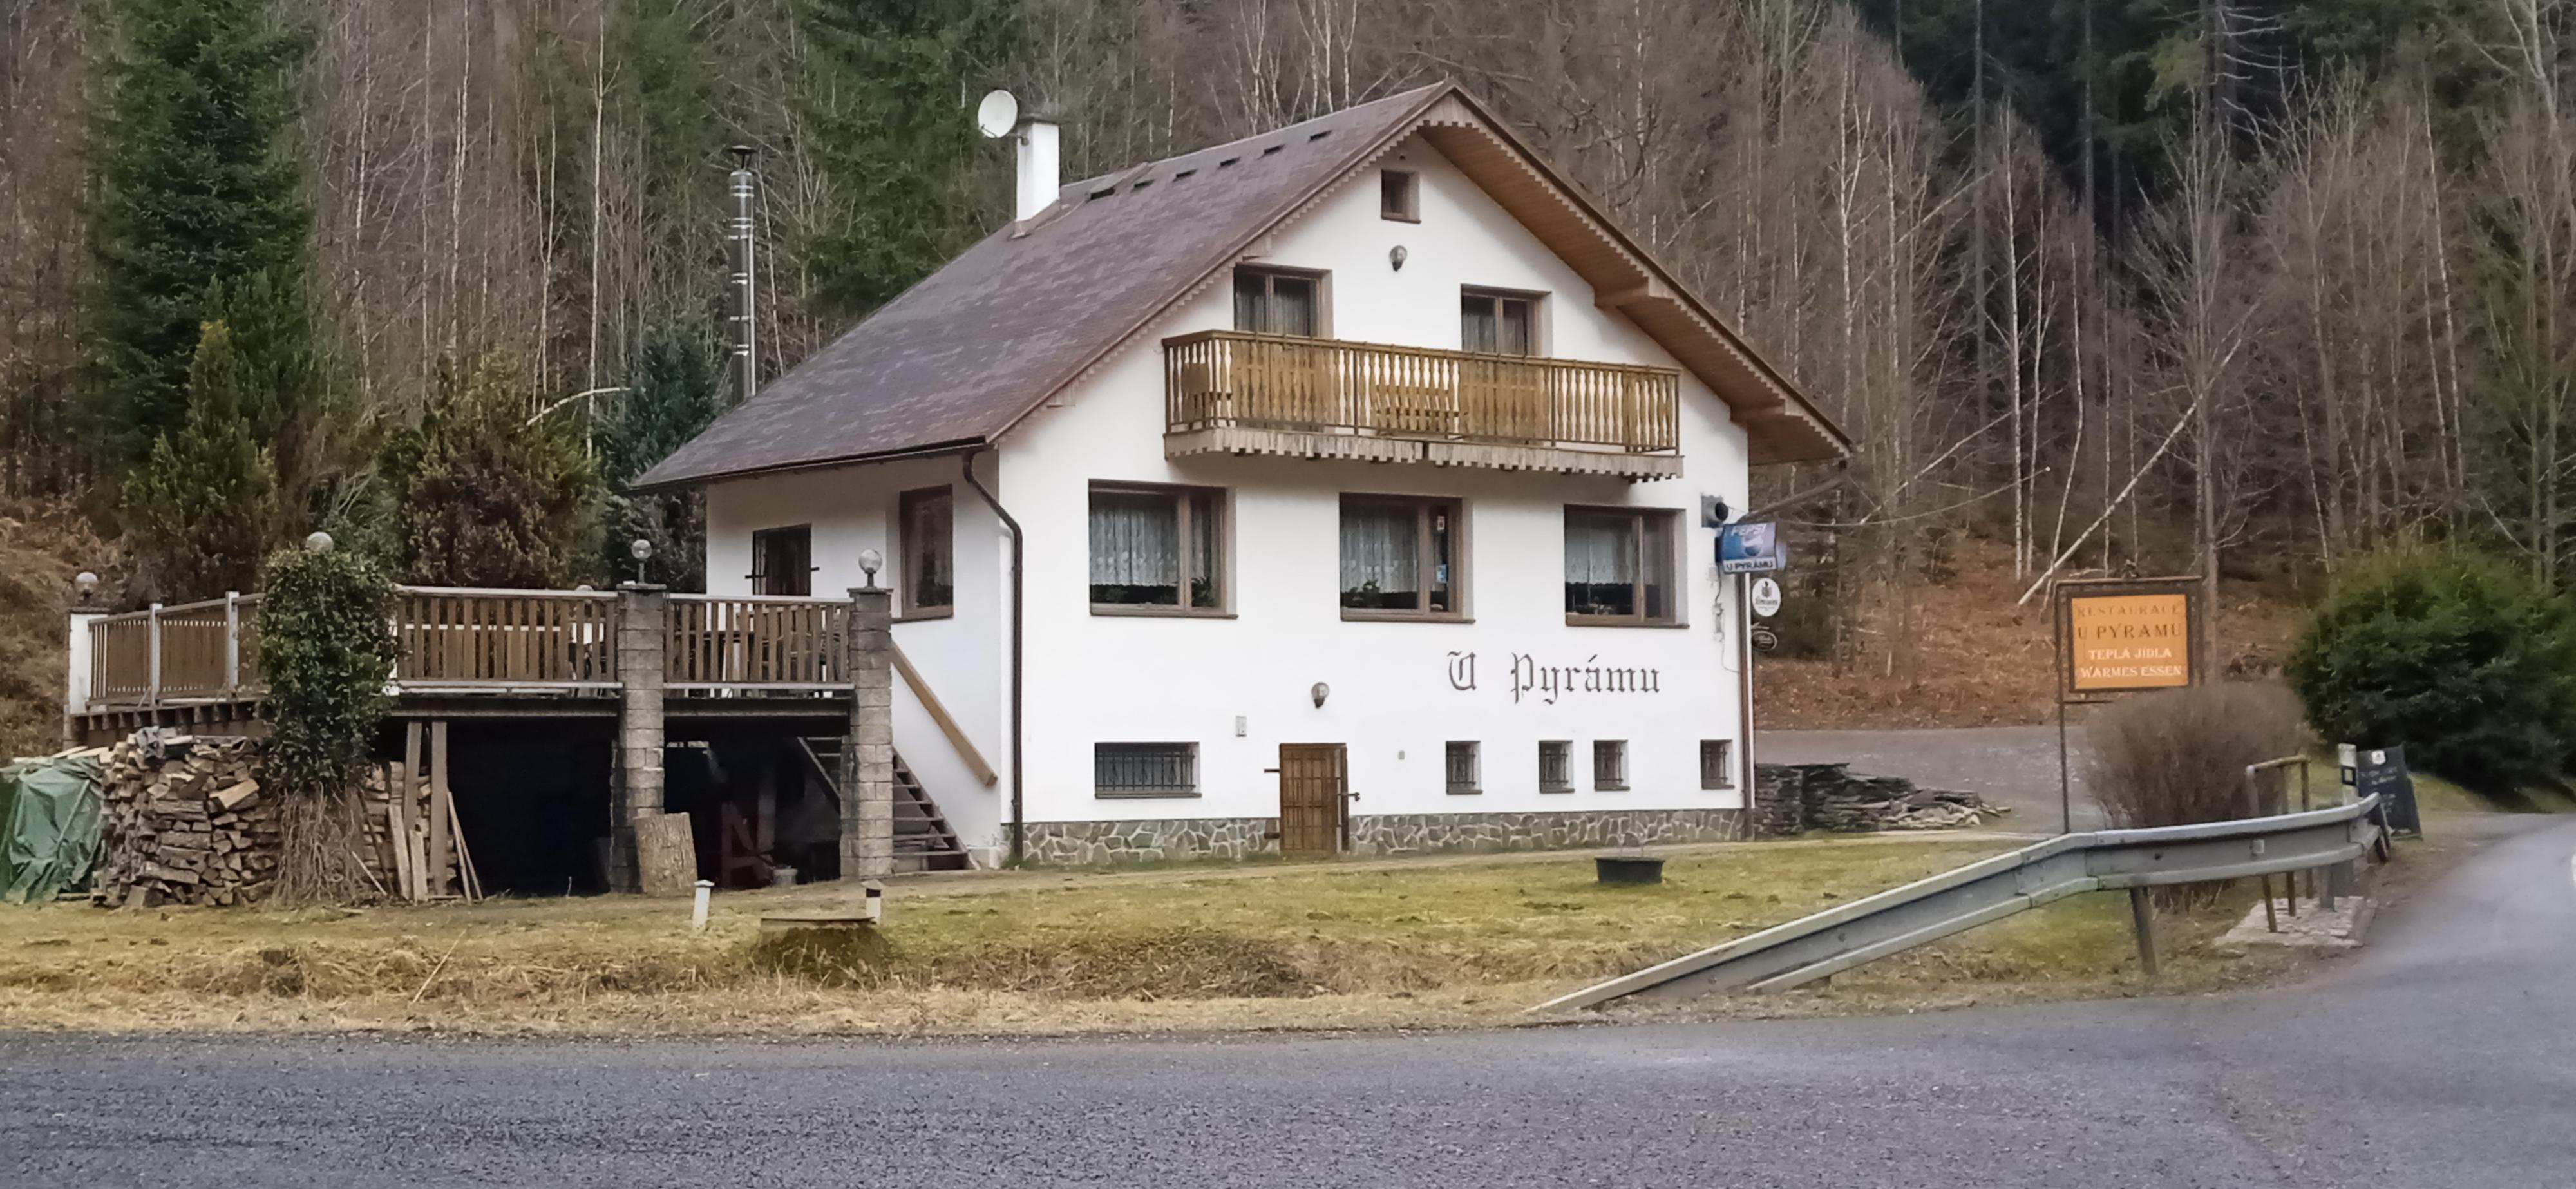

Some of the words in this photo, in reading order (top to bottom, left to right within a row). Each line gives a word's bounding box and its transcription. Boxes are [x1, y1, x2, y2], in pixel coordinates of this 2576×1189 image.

[1730, 523, 1767, 537] PEPSI
[2078, 626, 2088, 640] U
[2141, 665, 2182, 676] ESSEN
[1446, 651, 1477, 691] U
[1510, 652, 1660, 705] Pyrámu
